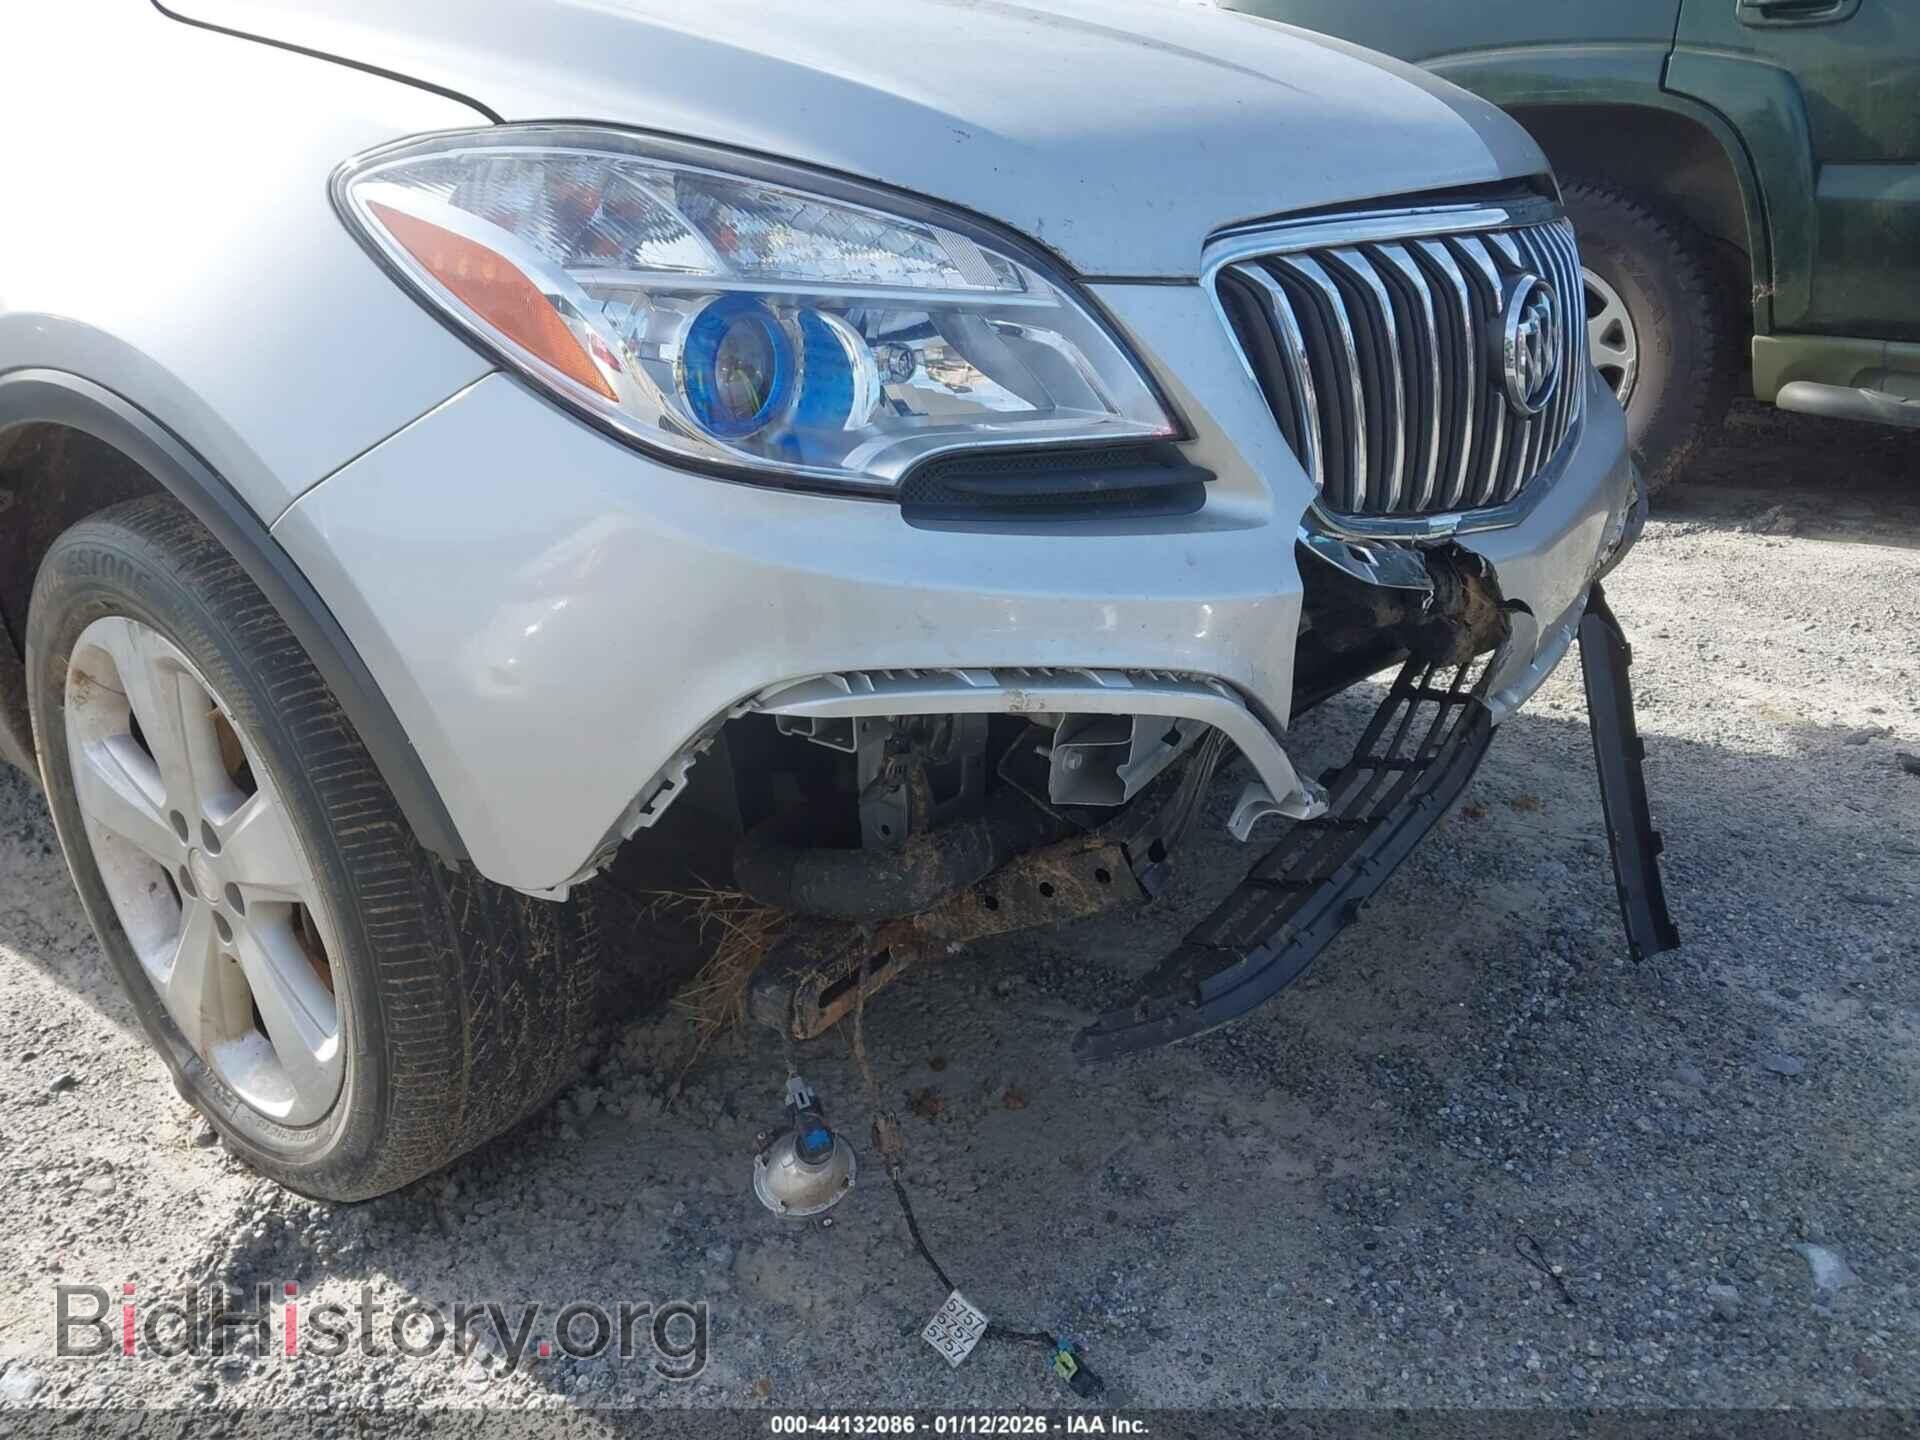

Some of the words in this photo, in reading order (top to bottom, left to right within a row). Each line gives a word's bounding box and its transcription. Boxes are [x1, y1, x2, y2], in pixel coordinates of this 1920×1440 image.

[936, 1312, 975, 1345] 5757
[946, 1298, 985, 1331] 5757
[927, 1324, 966, 1358] 5757
